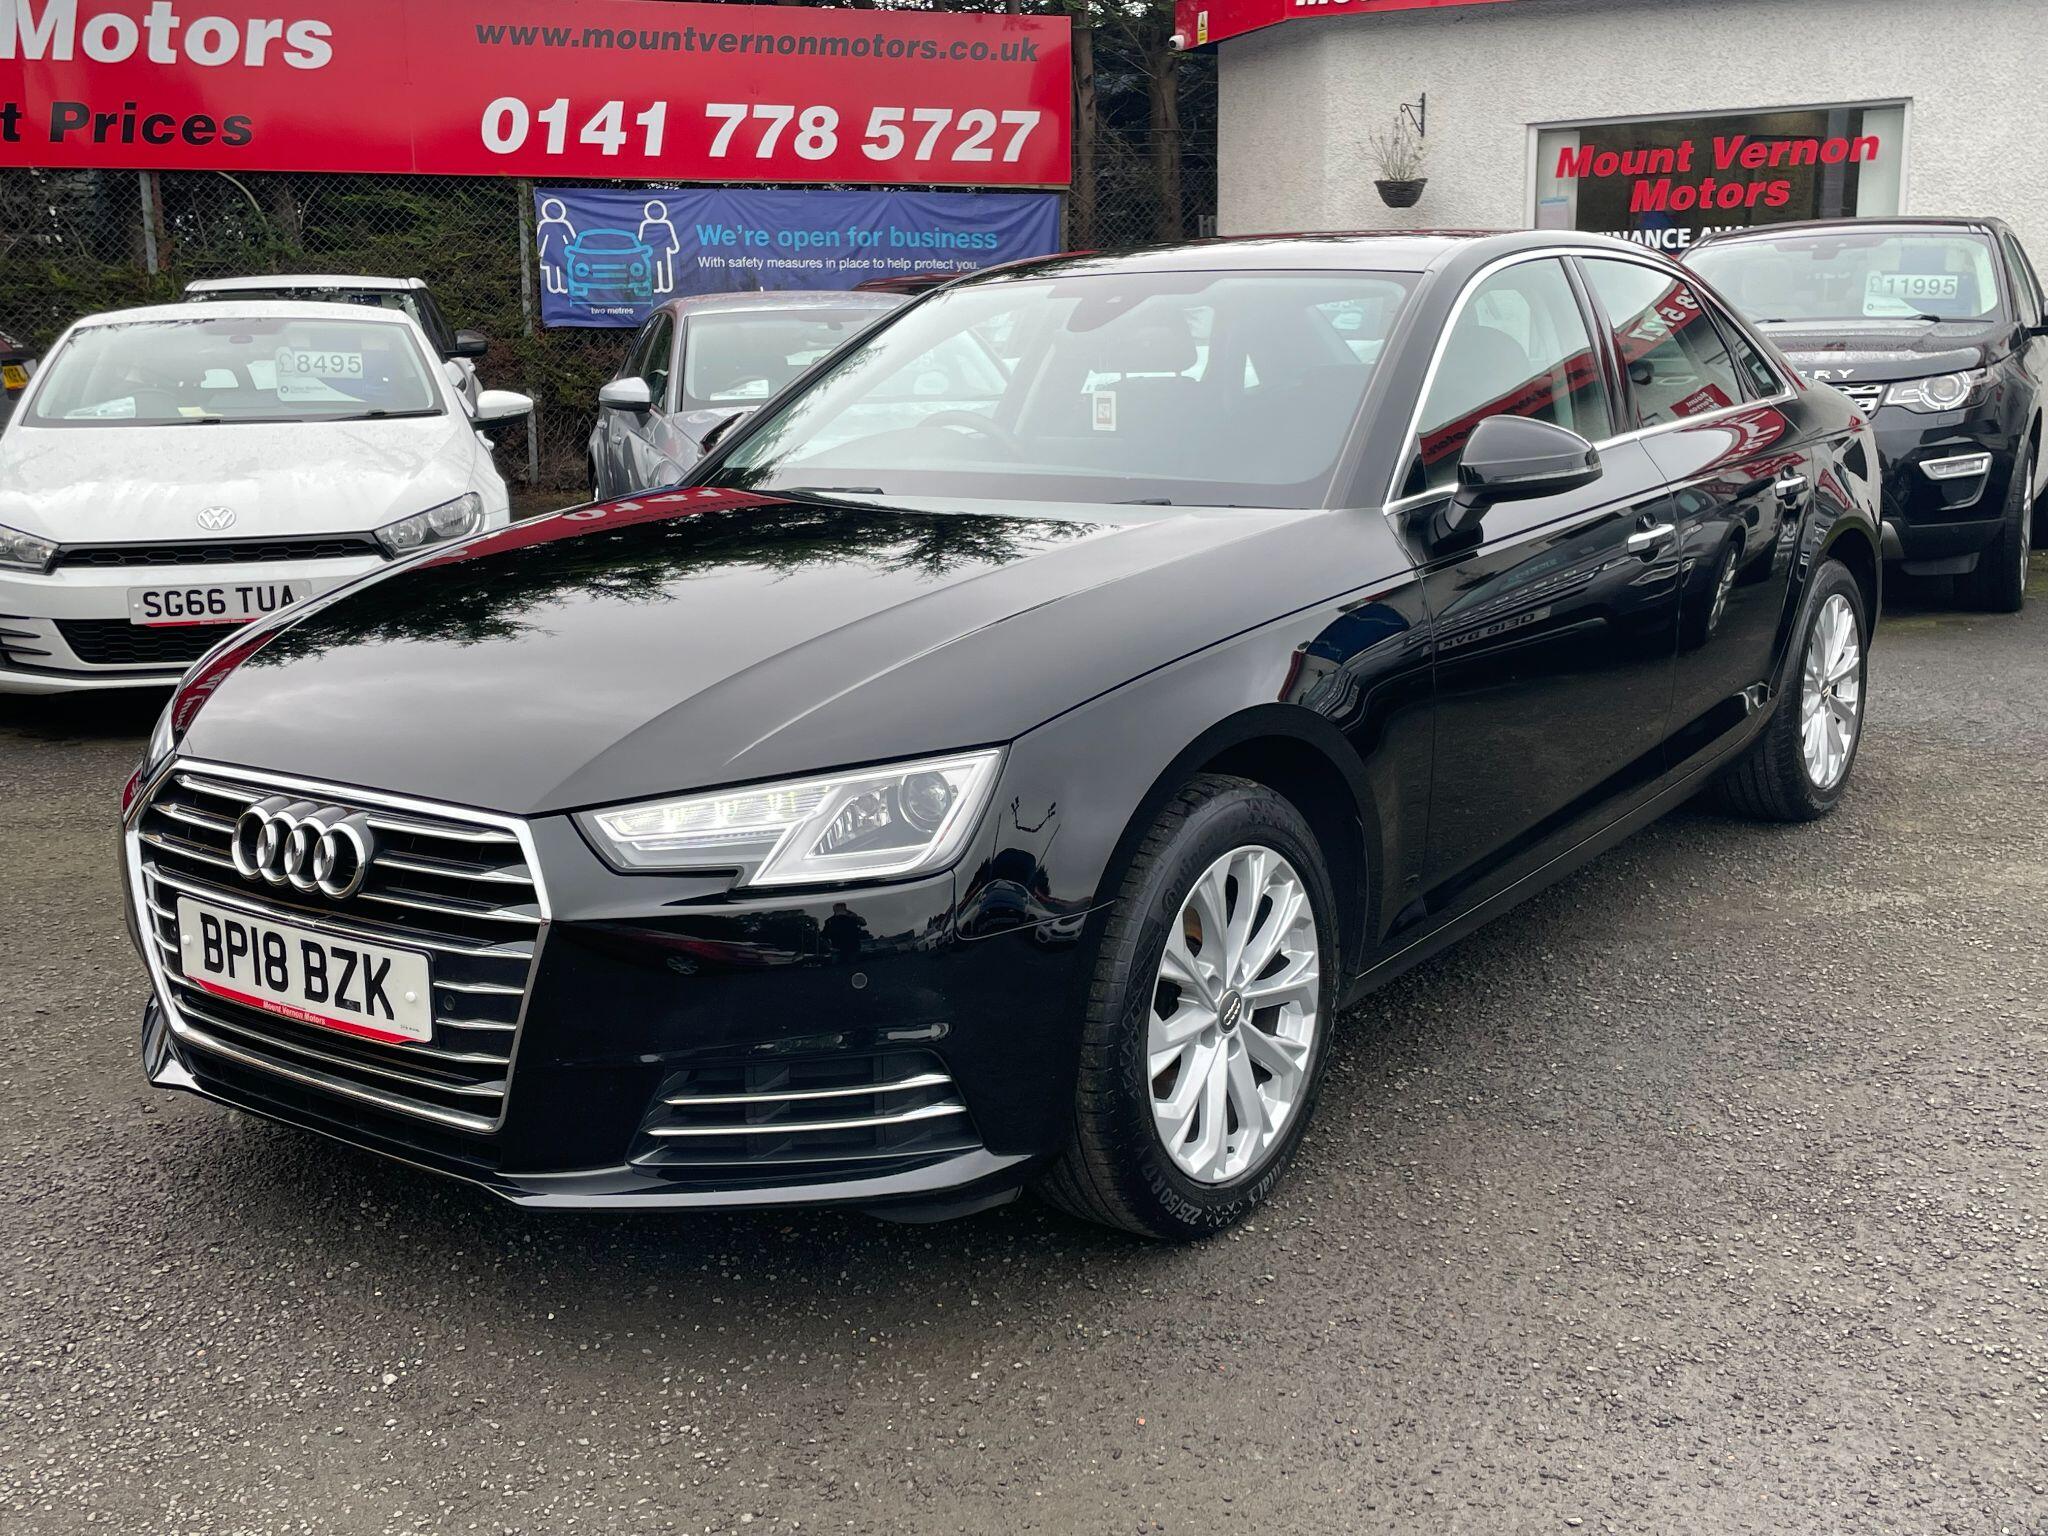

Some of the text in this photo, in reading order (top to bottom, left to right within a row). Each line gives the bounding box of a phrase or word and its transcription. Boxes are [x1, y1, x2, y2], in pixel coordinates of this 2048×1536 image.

[0, 0, 333, 69] Motors
[475, 23, 1039, 62] www.mountvernonmotors.co.uk
[49, 101, 253, 147] Prices
[481, 97, 1041, 163] 0141 778 5727
[1555, 135, 1880, 178] Mount Vernon
[1630, 177, 1791, 212] Motors
[777, 230, 840, 251] open
[847, 225, 883, 247] for
[890, 226, 998, 249] business
[698, 256, 980, 272] With safety measures in place to help protect you.
[607, 307, 634, 315] metres
[142, 585, 295, 617] SG66 TUA
[200, 912, 395, 1020] BP18 BZK
[263, 1000, 326, 1025] Mount Vernon Motors
